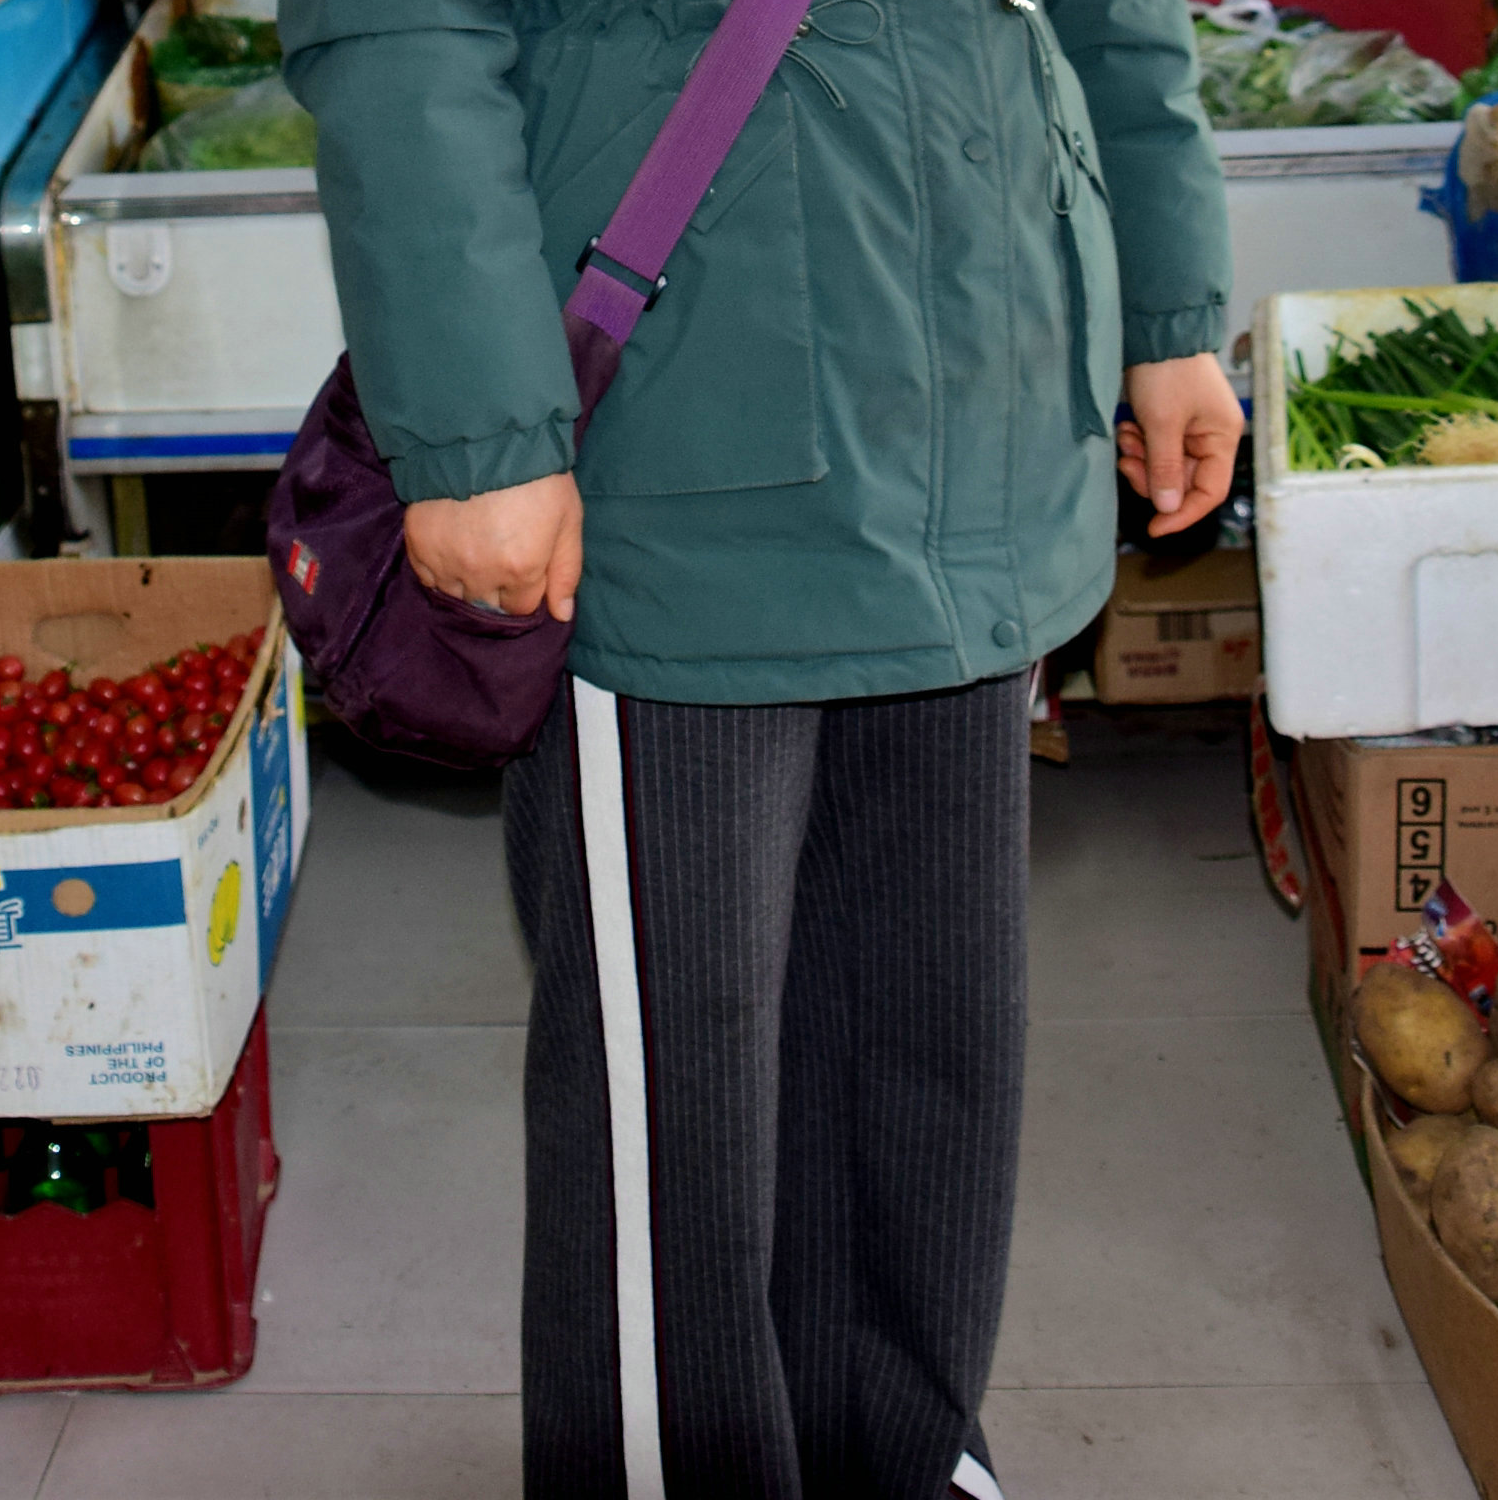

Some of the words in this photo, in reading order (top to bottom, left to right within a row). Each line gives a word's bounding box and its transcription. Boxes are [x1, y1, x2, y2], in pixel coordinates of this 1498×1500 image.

[1412, 786, 1432, 817] 6
[1411, 830, 1431, 860] 5
[1409, 874, 1432, 904] 4
[64, 1041, 165, 1057] PHILIPPINES
[107, 1058, 138, 1071] THE
[144, 1057, 165, 1071] OF
[89, 1071, 168, 1086] PRODUCT
